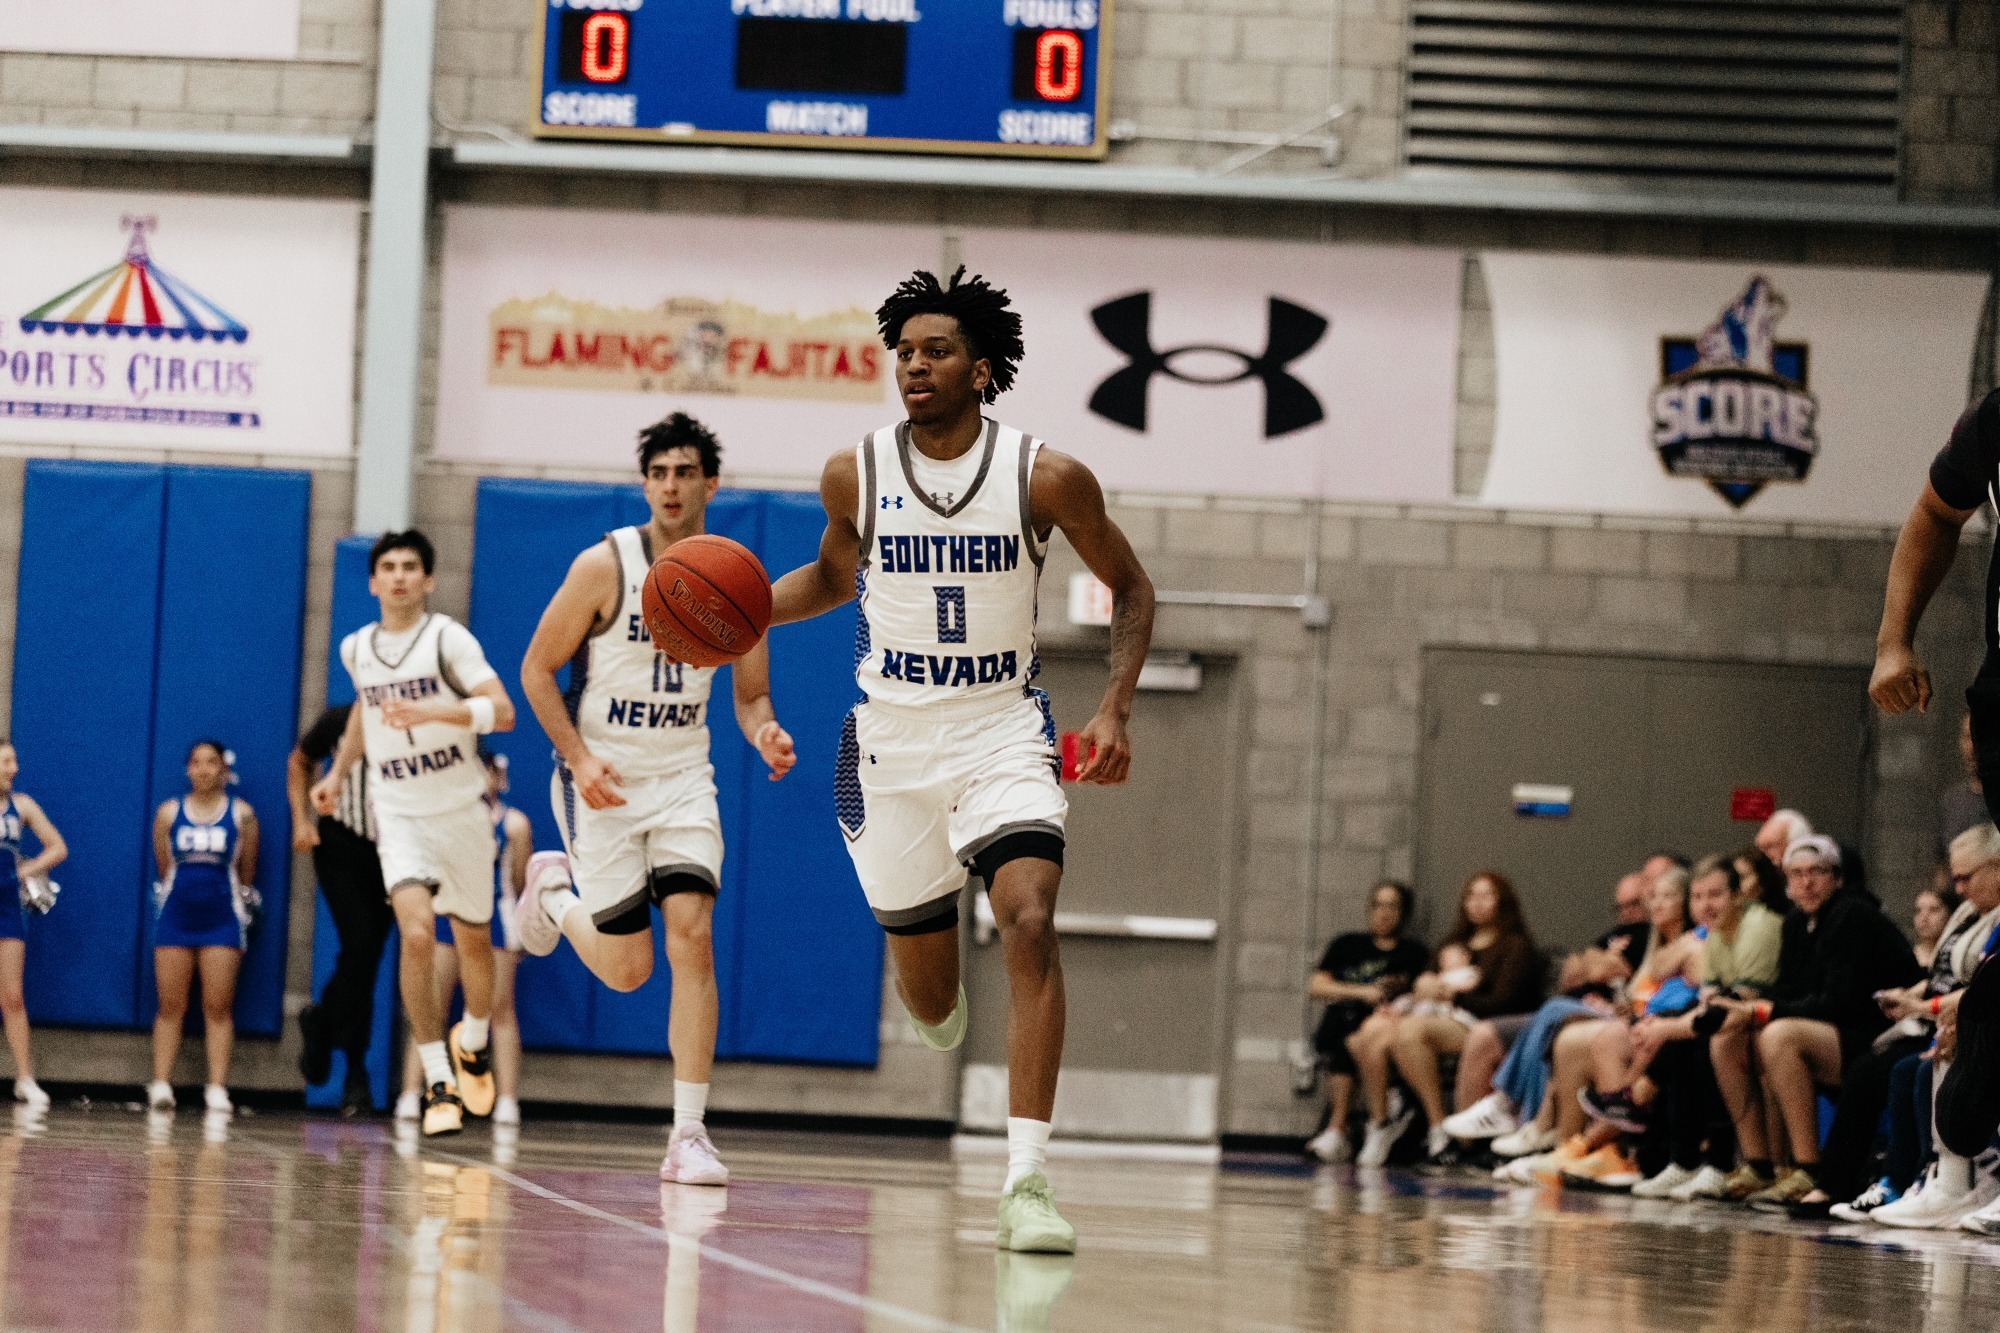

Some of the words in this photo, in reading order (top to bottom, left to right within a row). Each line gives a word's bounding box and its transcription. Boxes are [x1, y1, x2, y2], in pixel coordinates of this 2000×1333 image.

[581, 11, 629, 82] 0
[1035, 29, 1083, 102] 0
[543, 91, 637, 127] SCORE
[766, 101, 868, 136] MATCH
[998, 109, 1093, 146] SCORE
[495, 328, 675, 374] FLAMING
[727, 337, 881, 383] FAJITAS
[1652, 378, 1812, 451] SCORE
[878, 534, 1019, 573] SOUTHERN
[666, 577, 741, 648] SPALDING
[932, 585, 967, 644] 0
[652, 651, 684, 693] 10
[881, 648, 1017, 687] NEVADA
[380, 744, 465, 781] NEVADA
